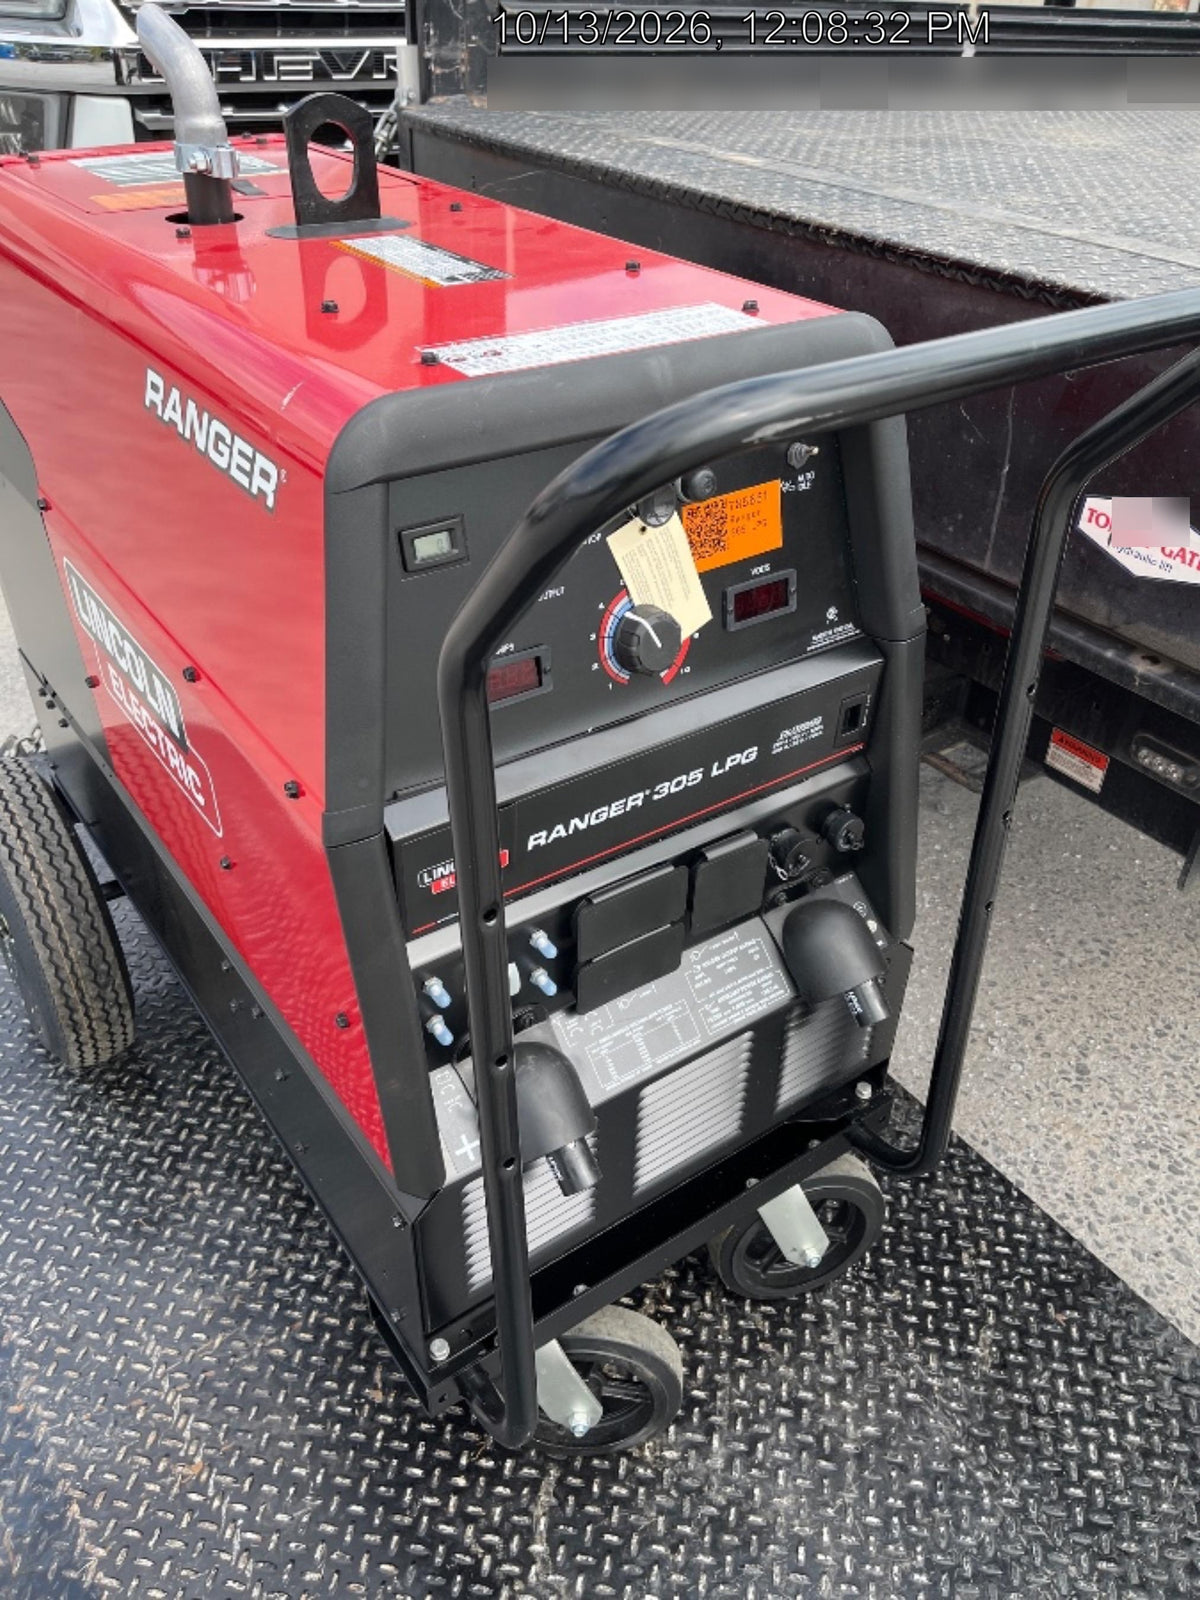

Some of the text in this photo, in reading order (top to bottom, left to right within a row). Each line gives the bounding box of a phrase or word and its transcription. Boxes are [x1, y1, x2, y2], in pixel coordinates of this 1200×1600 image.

[145, 367, 279, 509] RANGER
[71, 576, 180, 739] LINCOLN
[106, 662, 206, 806] ELECTRIC
[527, 746, 759, 851] RANGER 305 LPG
